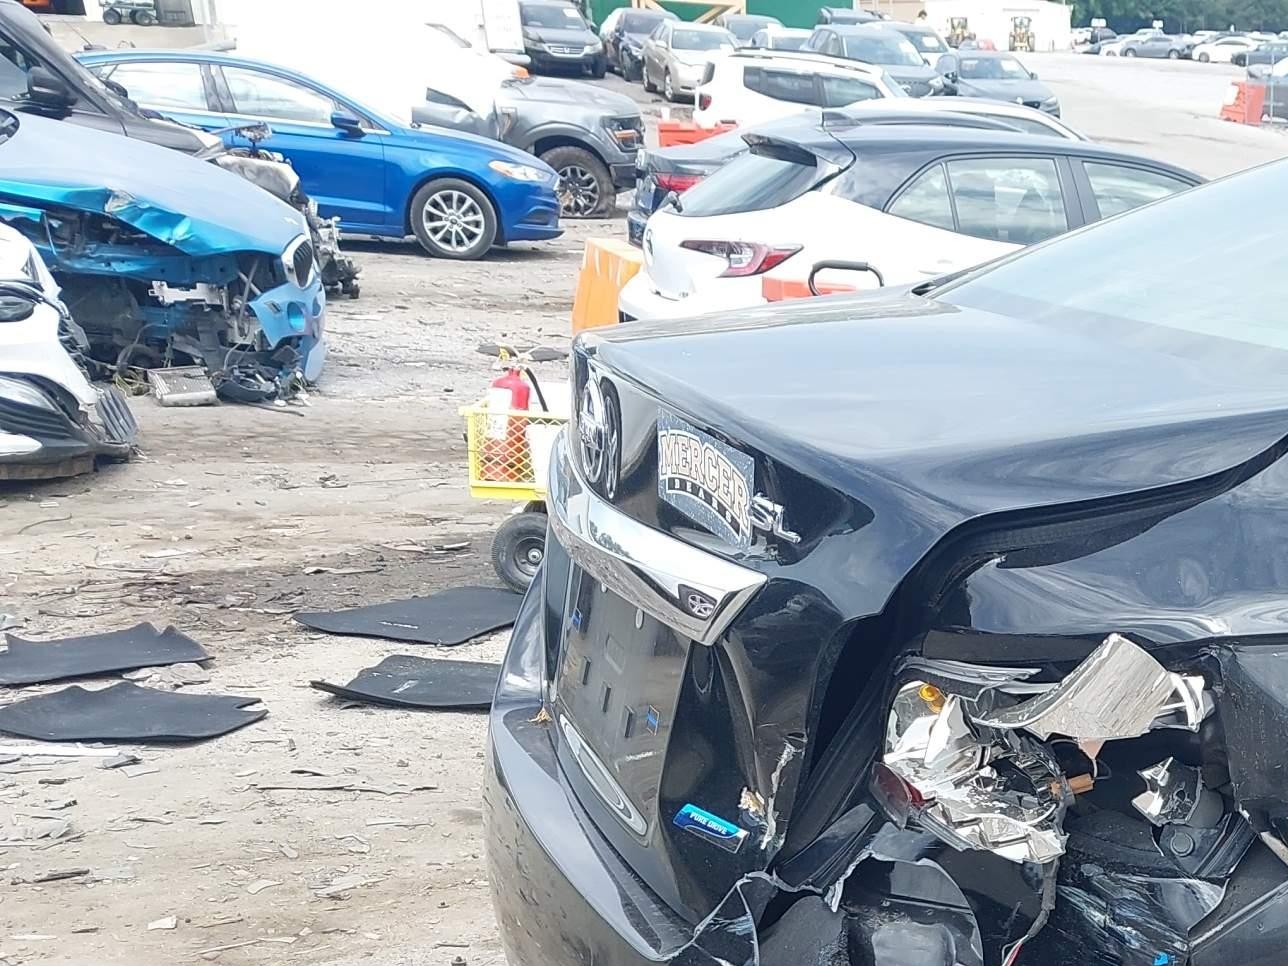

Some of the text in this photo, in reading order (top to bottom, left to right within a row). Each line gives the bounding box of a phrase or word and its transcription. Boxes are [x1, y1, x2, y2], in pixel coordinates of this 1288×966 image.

[660, 431, 750, 534] MERCER
[674, 478, 733, 523] BEARS
[749, 492, 802, 544] SL
[690, 812, 728, 835] PURE DRIVE
